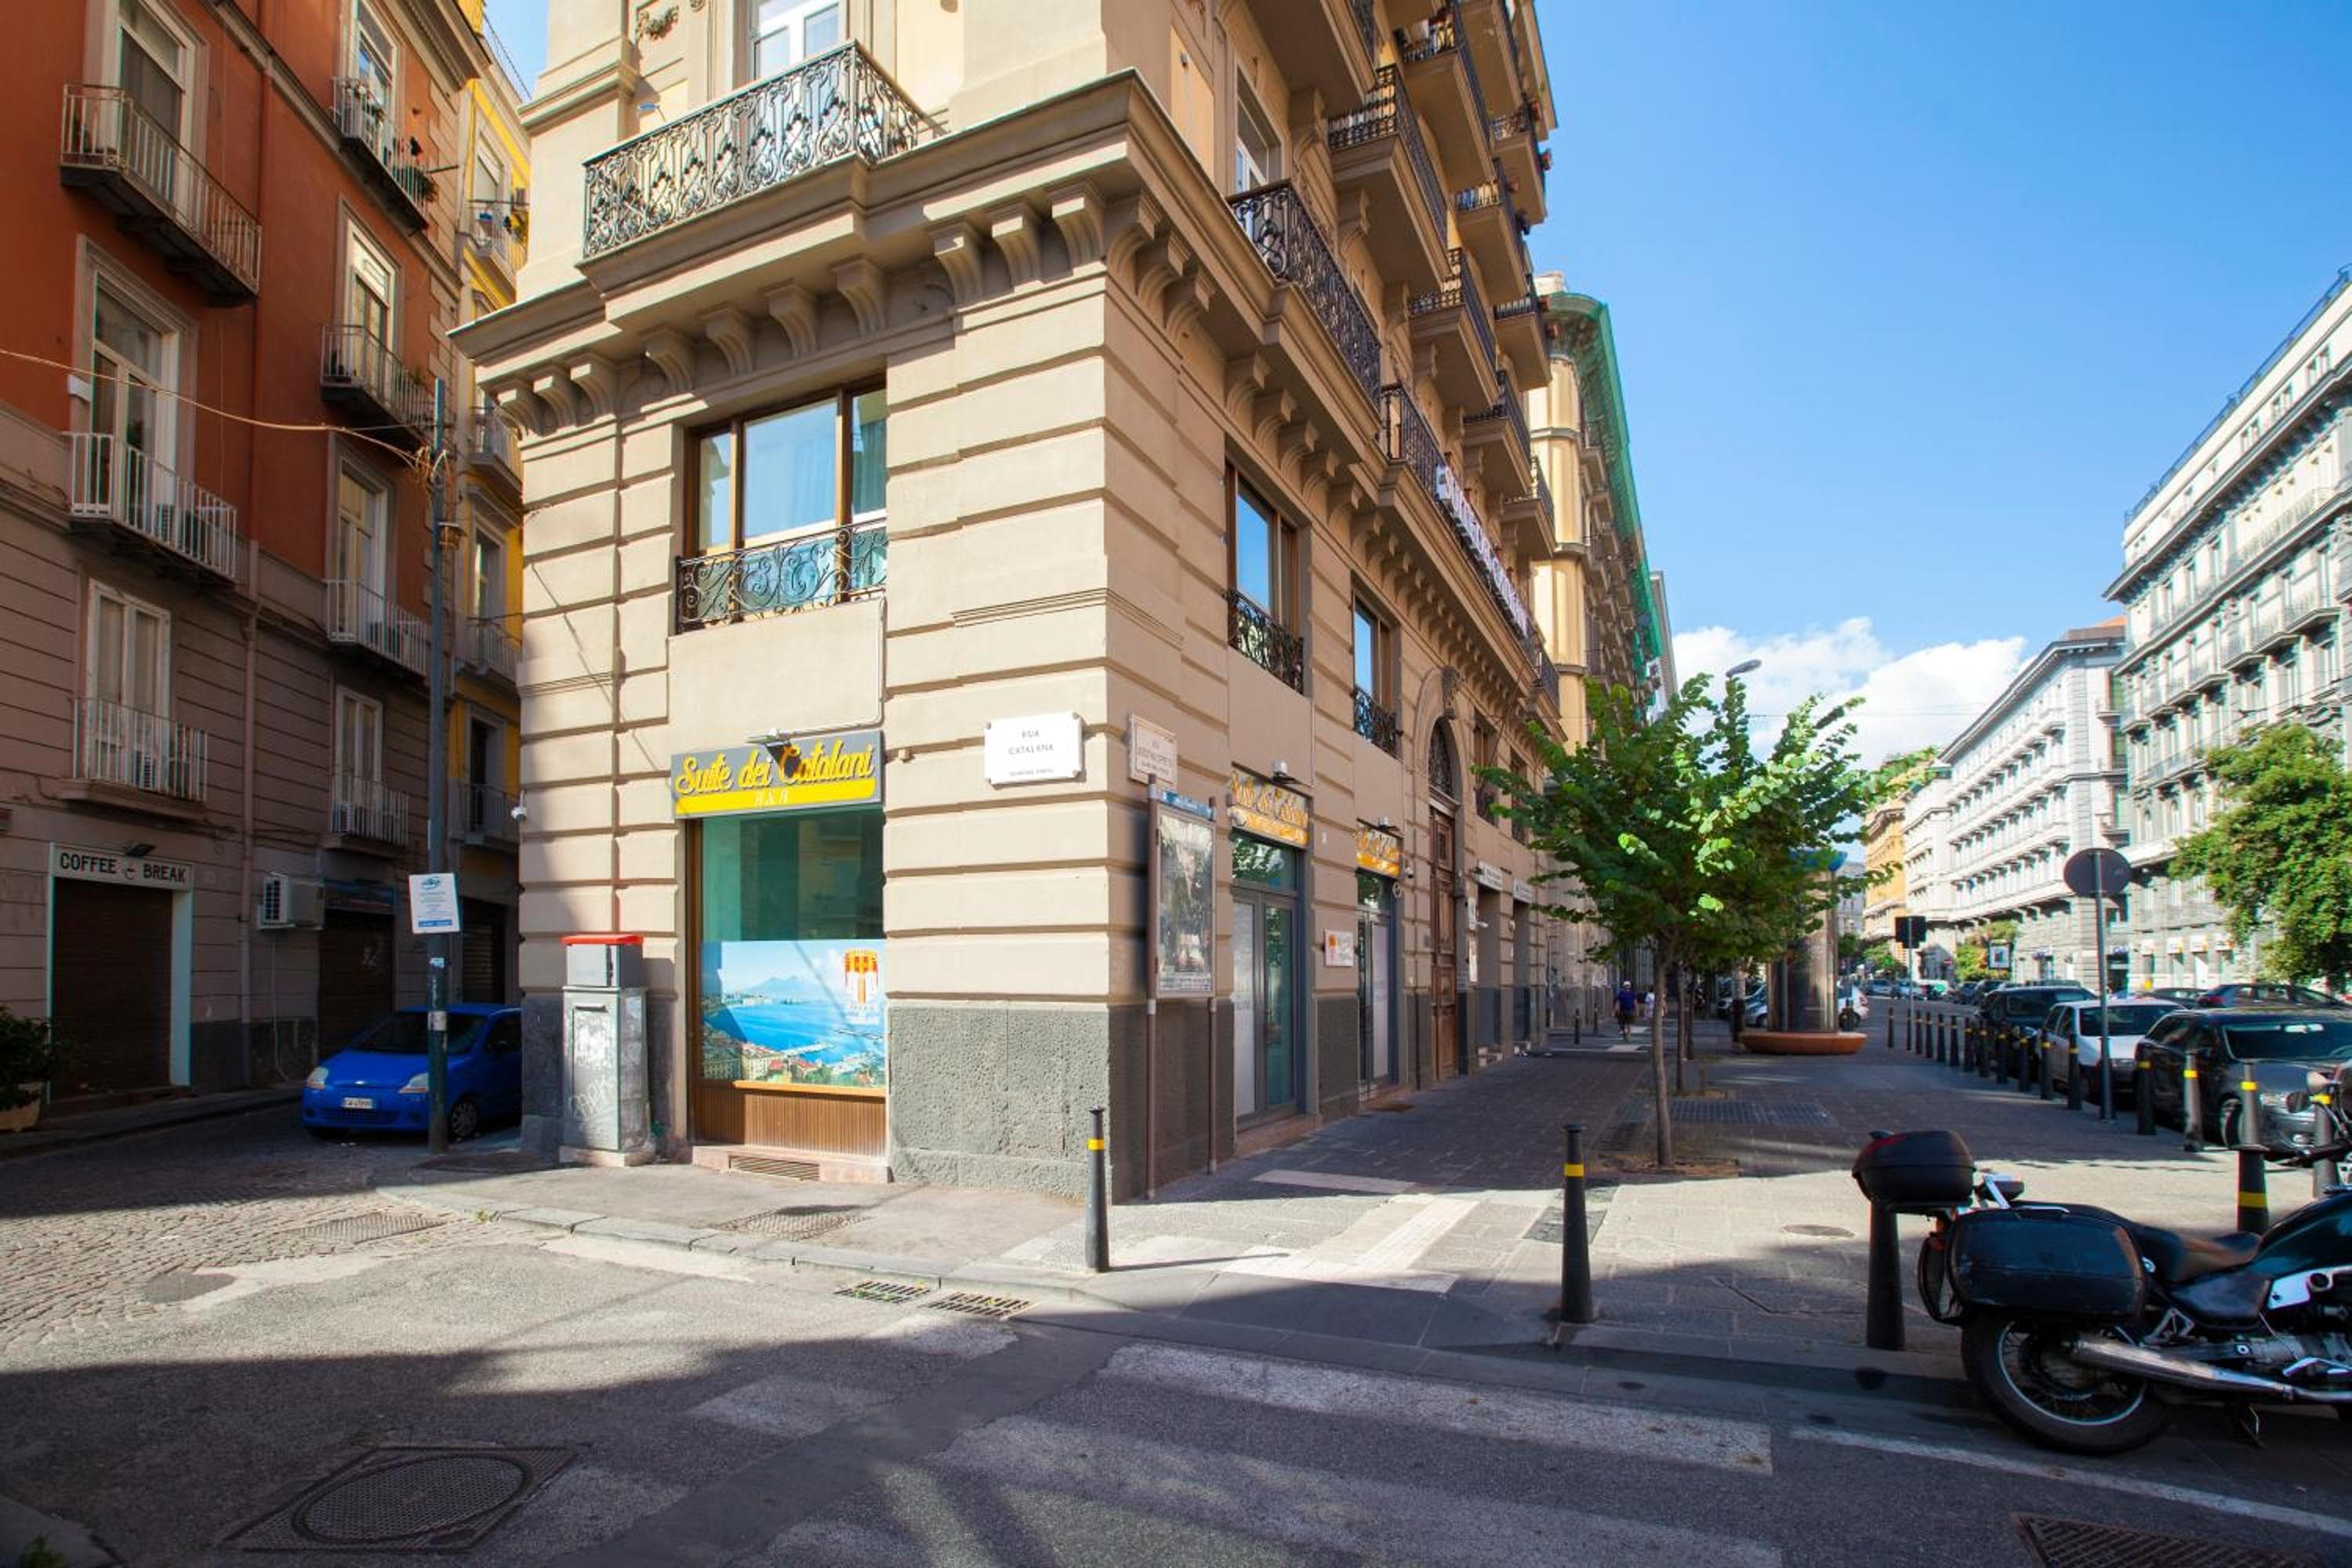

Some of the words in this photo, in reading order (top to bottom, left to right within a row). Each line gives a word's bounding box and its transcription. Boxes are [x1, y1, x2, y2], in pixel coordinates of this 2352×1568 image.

[675, 753, 733, 794] Suite
[738, 750, 773, 789] dei
[779, 740, 875, 785] Catalani
[60, 852, 117, 874] COFFEE
[143, 863, 186, 883] BREAK
